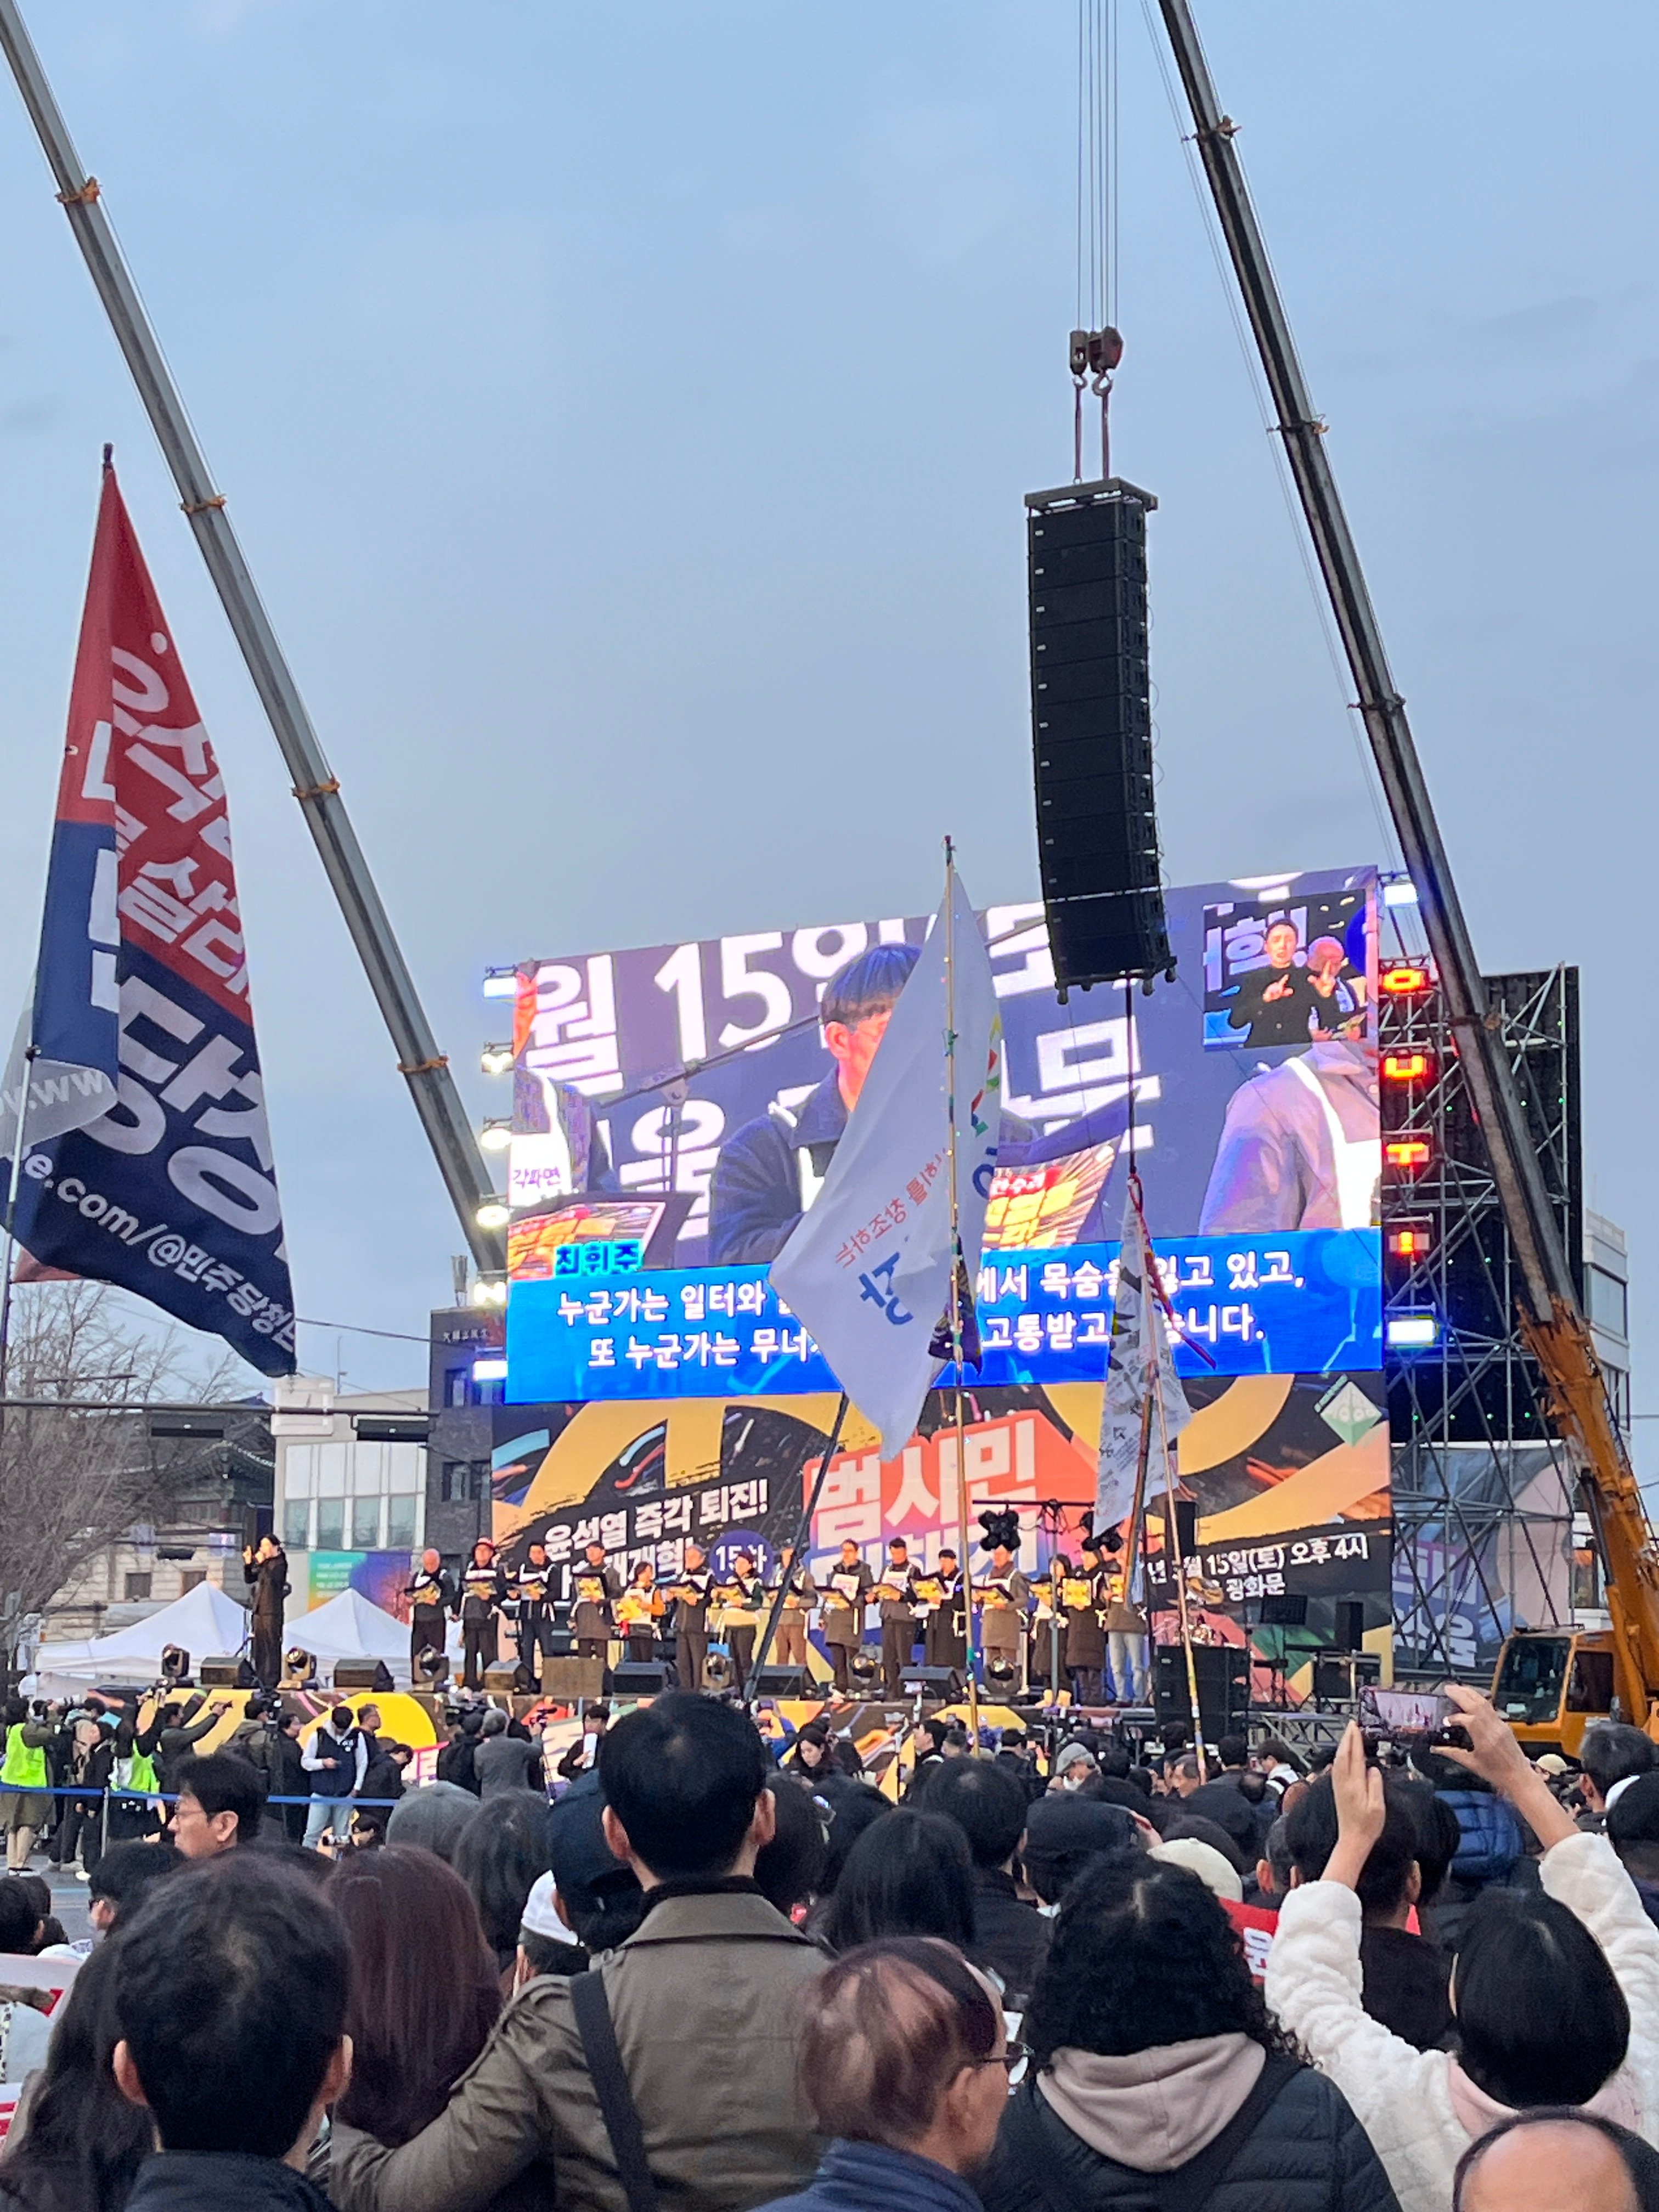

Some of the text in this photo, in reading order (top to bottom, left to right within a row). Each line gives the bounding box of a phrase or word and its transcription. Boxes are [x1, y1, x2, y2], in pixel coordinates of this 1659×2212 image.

[557, 1287, 670, 1327] 누군가는
[680, 1280, 766, 1321] 일터와
[1227, 1251, 1305, 1290] 있고,
[588, 1338, 616, 1367] 또
[625, 1331, 740, 1369] 누군가는
[751, 1326, 819, 1364] 무너
[981, 1311, 1109, 1351] 고통받고
[545, 1479, 768, 1562] 윤석열 즉각 퇴진!
[810, 1418, 1037, 1550] 범시민
[1226, 1572, 1286, 1601] 광화문
